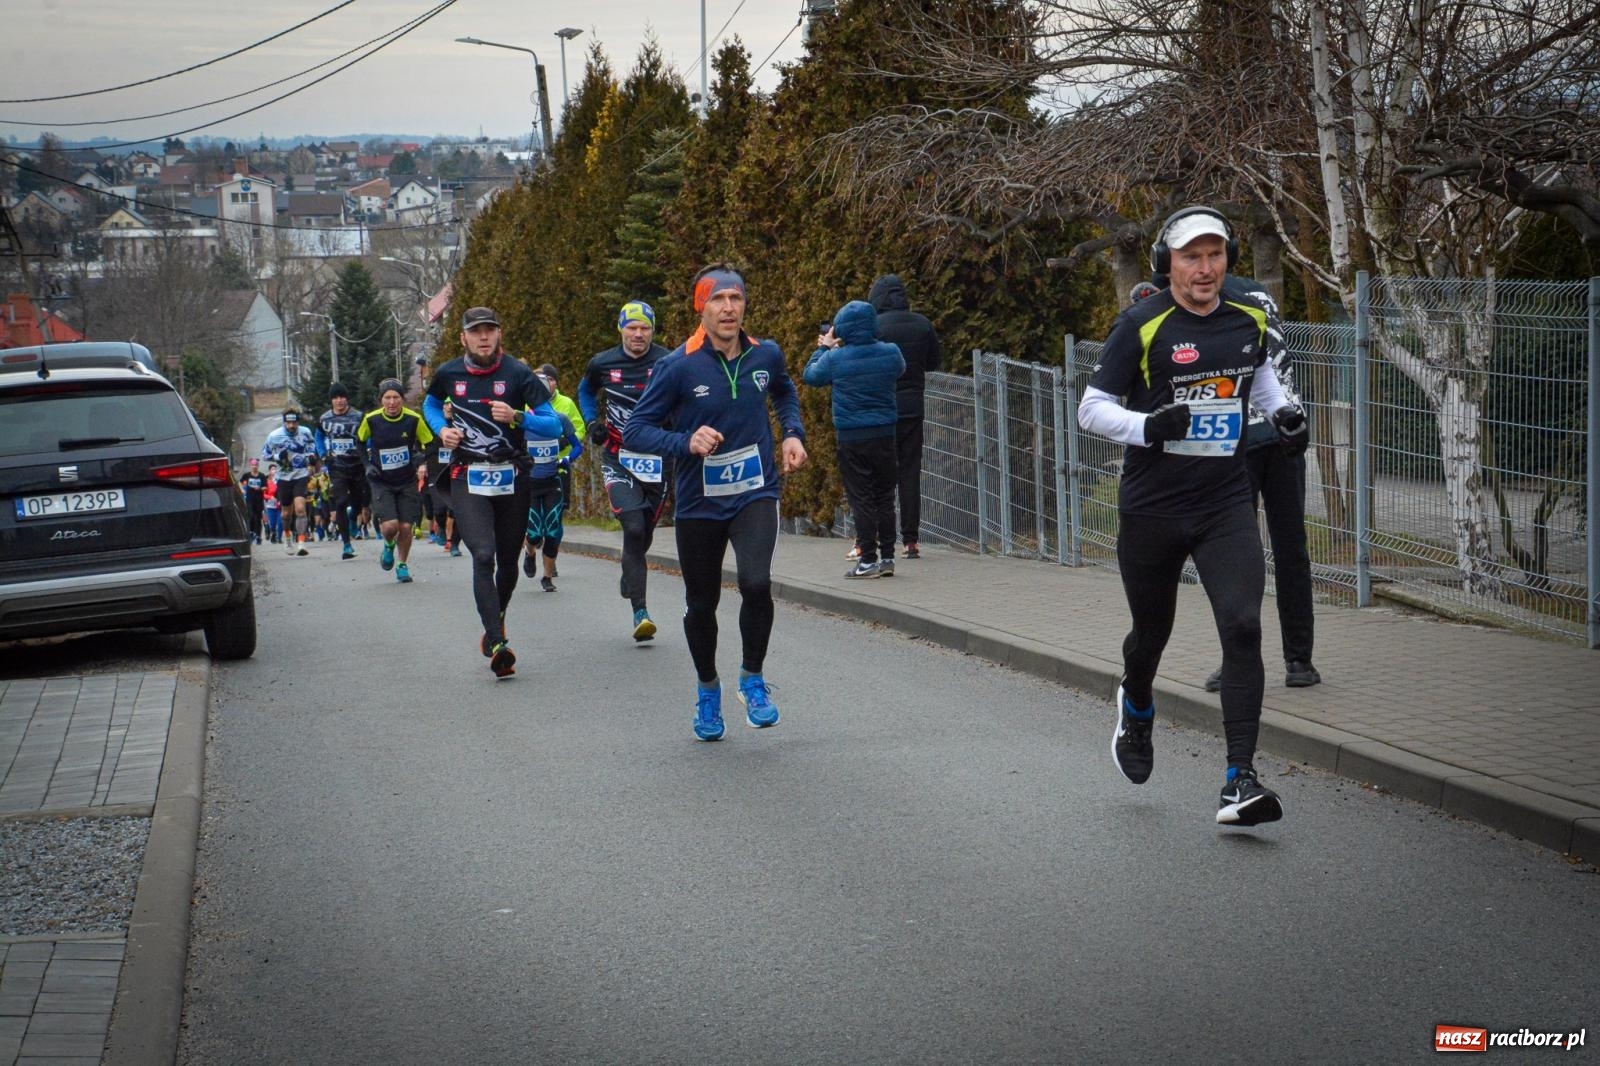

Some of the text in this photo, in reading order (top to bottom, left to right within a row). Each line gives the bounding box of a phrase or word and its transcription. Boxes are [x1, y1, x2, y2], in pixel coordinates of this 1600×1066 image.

[1172, 343, 1196, 351] EASY
[1176, 352, 1196, 360] RUN
[1172, 370, 1221, 383] ENERGETYKA
[385, 453, 405, 464] 200
[536, 447, 551, 458] 90
[626, 459, 655, 473] 163
[720, 461, 745, 483] 47
[481, 471, 502, 486] 29
[28, 491, 119, 515] OP 1239P
[50, 529, 101, 541] Ateca
